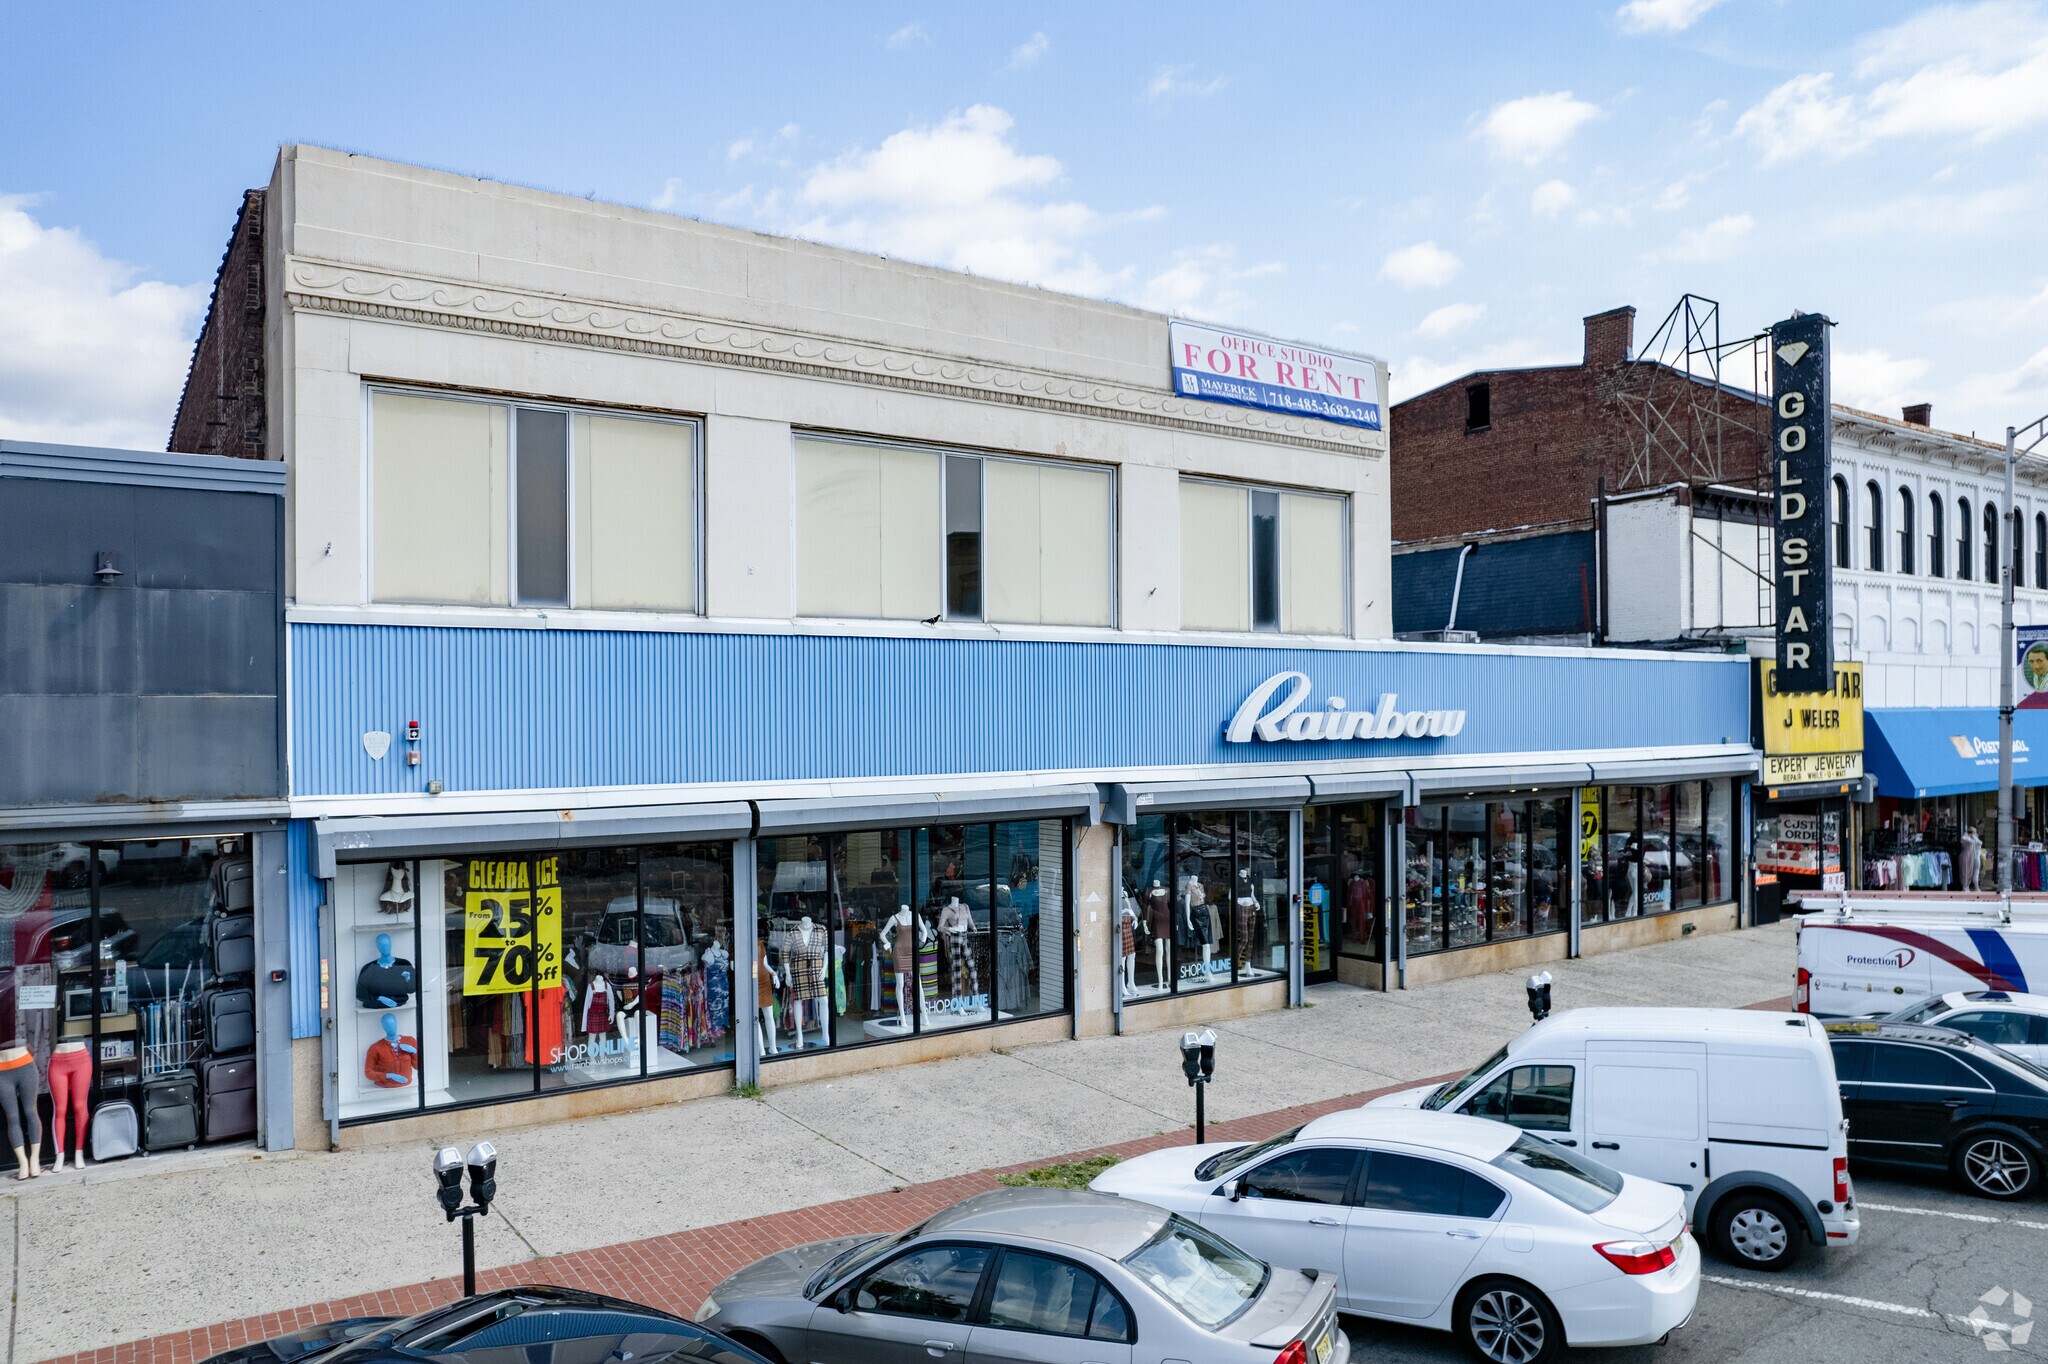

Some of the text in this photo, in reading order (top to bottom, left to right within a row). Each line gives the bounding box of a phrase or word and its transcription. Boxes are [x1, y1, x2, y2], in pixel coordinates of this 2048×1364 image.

[1221, 335, 1333, 370] OFFICE STUDIO
[1183, 343, 1365, 400] FOR RENT
[1200, 378, 1257, 397] MAVERICK
[1201, 387, 1242, 400] MANAGEMENT
[1269, 392, 1377, 423] 718-485-3682x240
[1779, 392, 1806, 520] GOLD
[1782, 538, 1810, 669] STAR
[1226, 671, 1466, 742] Rainbow
[1771, 754, 1857, 774] EXPERT JEWELRY
[1783, 772, 1802, 782] REPAIR
[1847, 955, 1897, 966] Protection
